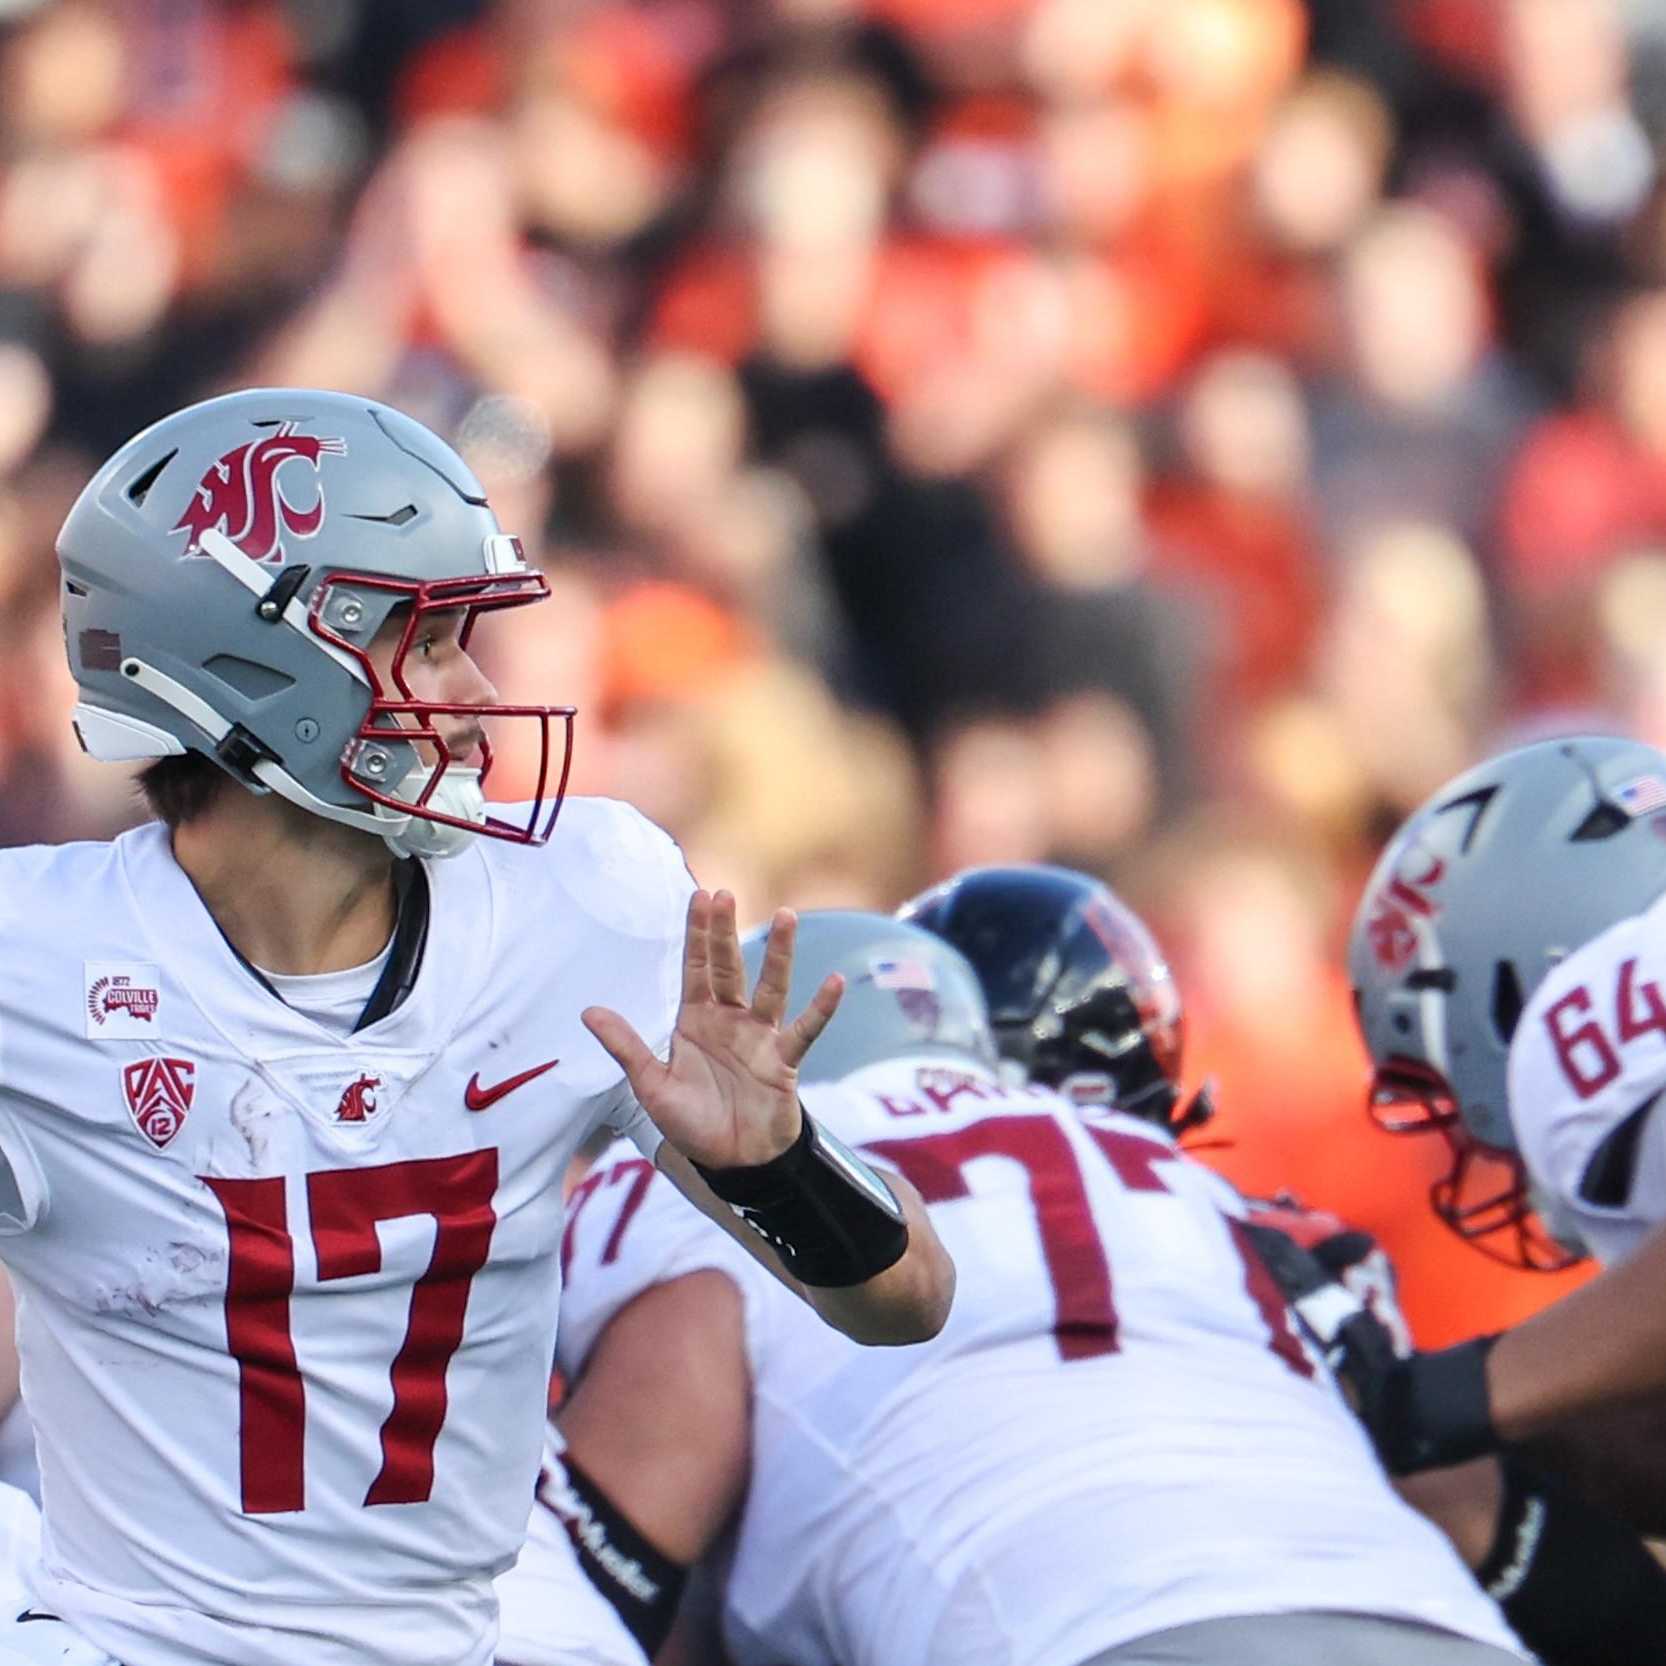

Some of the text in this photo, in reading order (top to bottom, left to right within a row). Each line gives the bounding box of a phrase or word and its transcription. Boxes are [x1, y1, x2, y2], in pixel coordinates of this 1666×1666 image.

[107, 989, 157, 1004] COLVILLE
[150, 1116, 172, 1136] 12
[195, 1146, 501, 1515] 17
